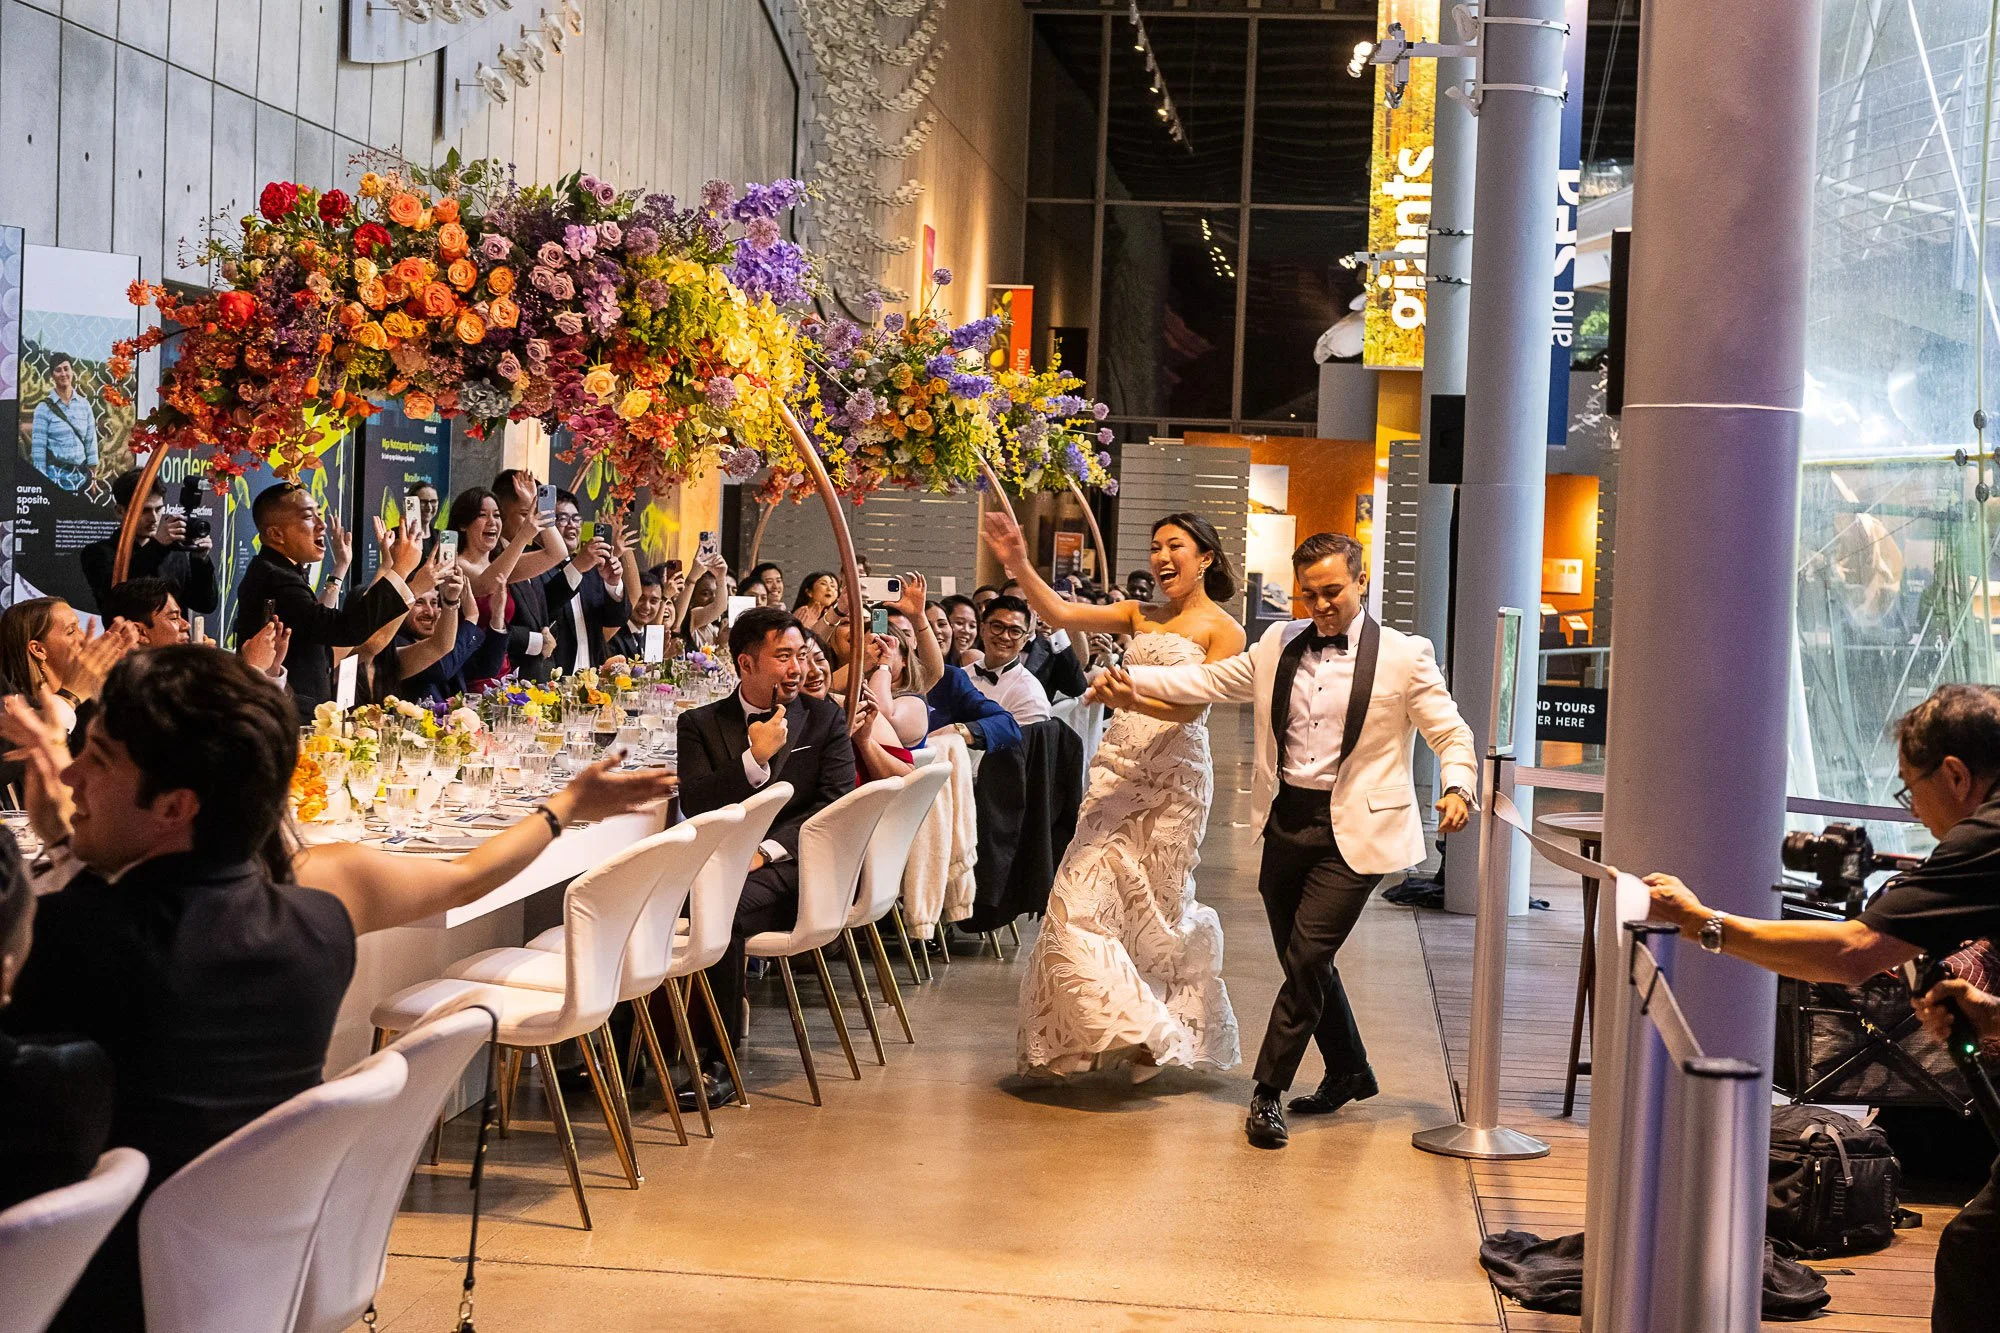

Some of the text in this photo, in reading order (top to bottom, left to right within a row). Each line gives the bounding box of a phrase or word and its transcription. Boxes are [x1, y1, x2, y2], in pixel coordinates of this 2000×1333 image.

[16, 485, 42, 494] auren
[16, 495, 51, 505] sposito,
[16, 505, 30, 515] hD
[1555, 701, 1596, 714] TOURS
[1555, 716, 1585, 728] HERE
